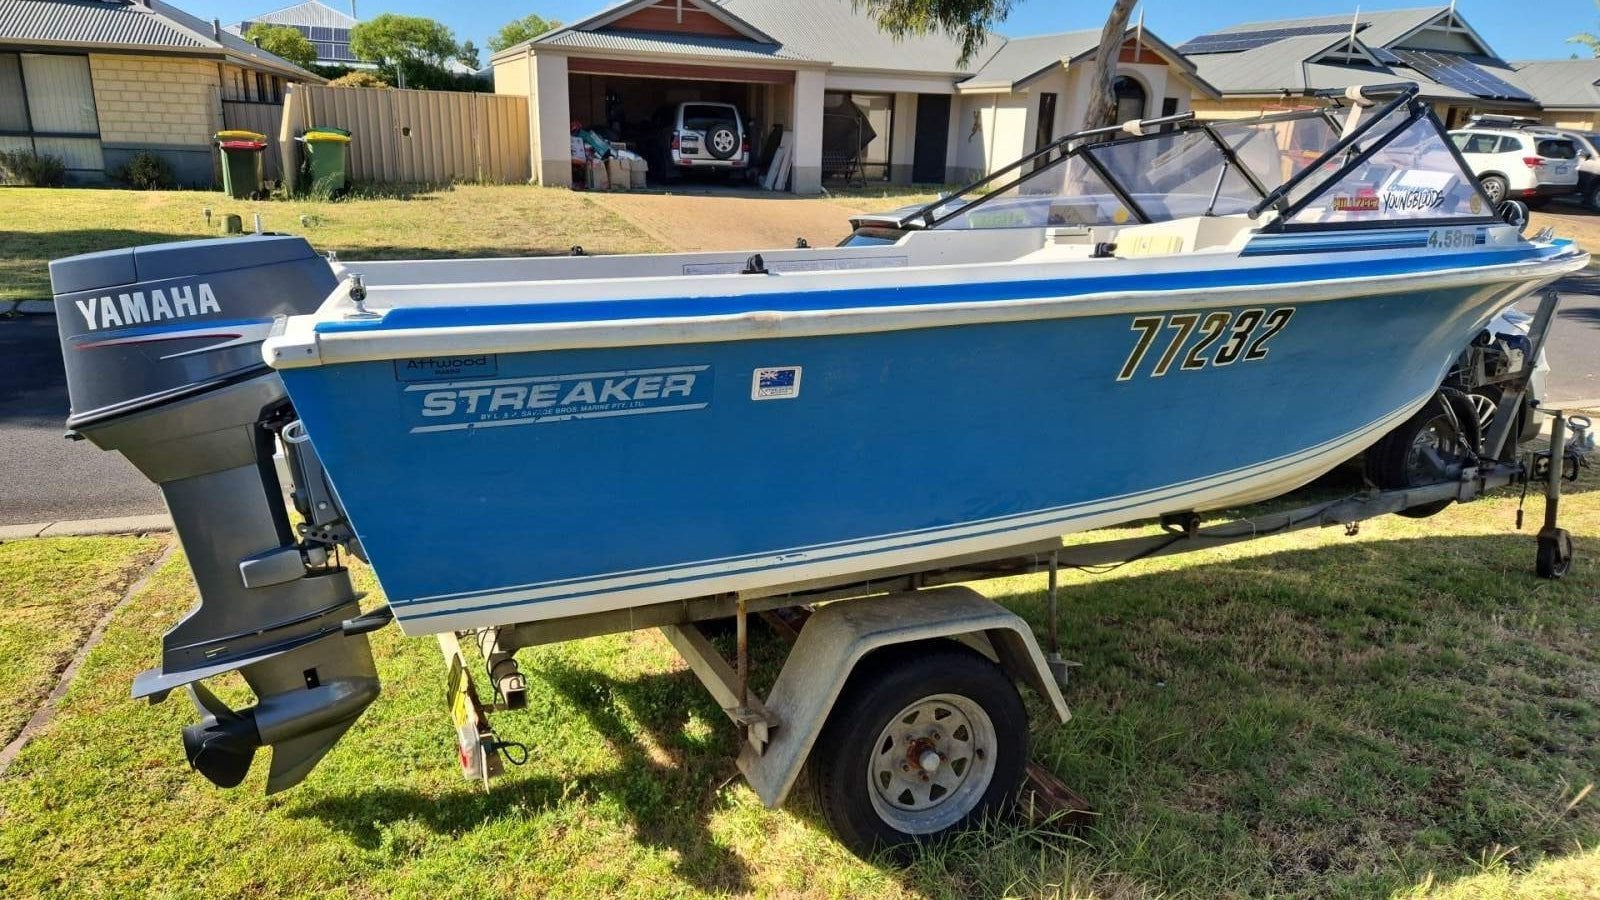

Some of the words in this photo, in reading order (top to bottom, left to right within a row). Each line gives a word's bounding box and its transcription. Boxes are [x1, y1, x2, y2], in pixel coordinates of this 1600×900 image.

[1383, 190, 1444, 213] YOUNGBLOODS
[1429, 230, 1475, 248] 4.58m
[76, 283, 221, 330] YAMAHA
[1116, 307, 1296, 381] 77232
[422, 373, 696, 417] STREAKER
